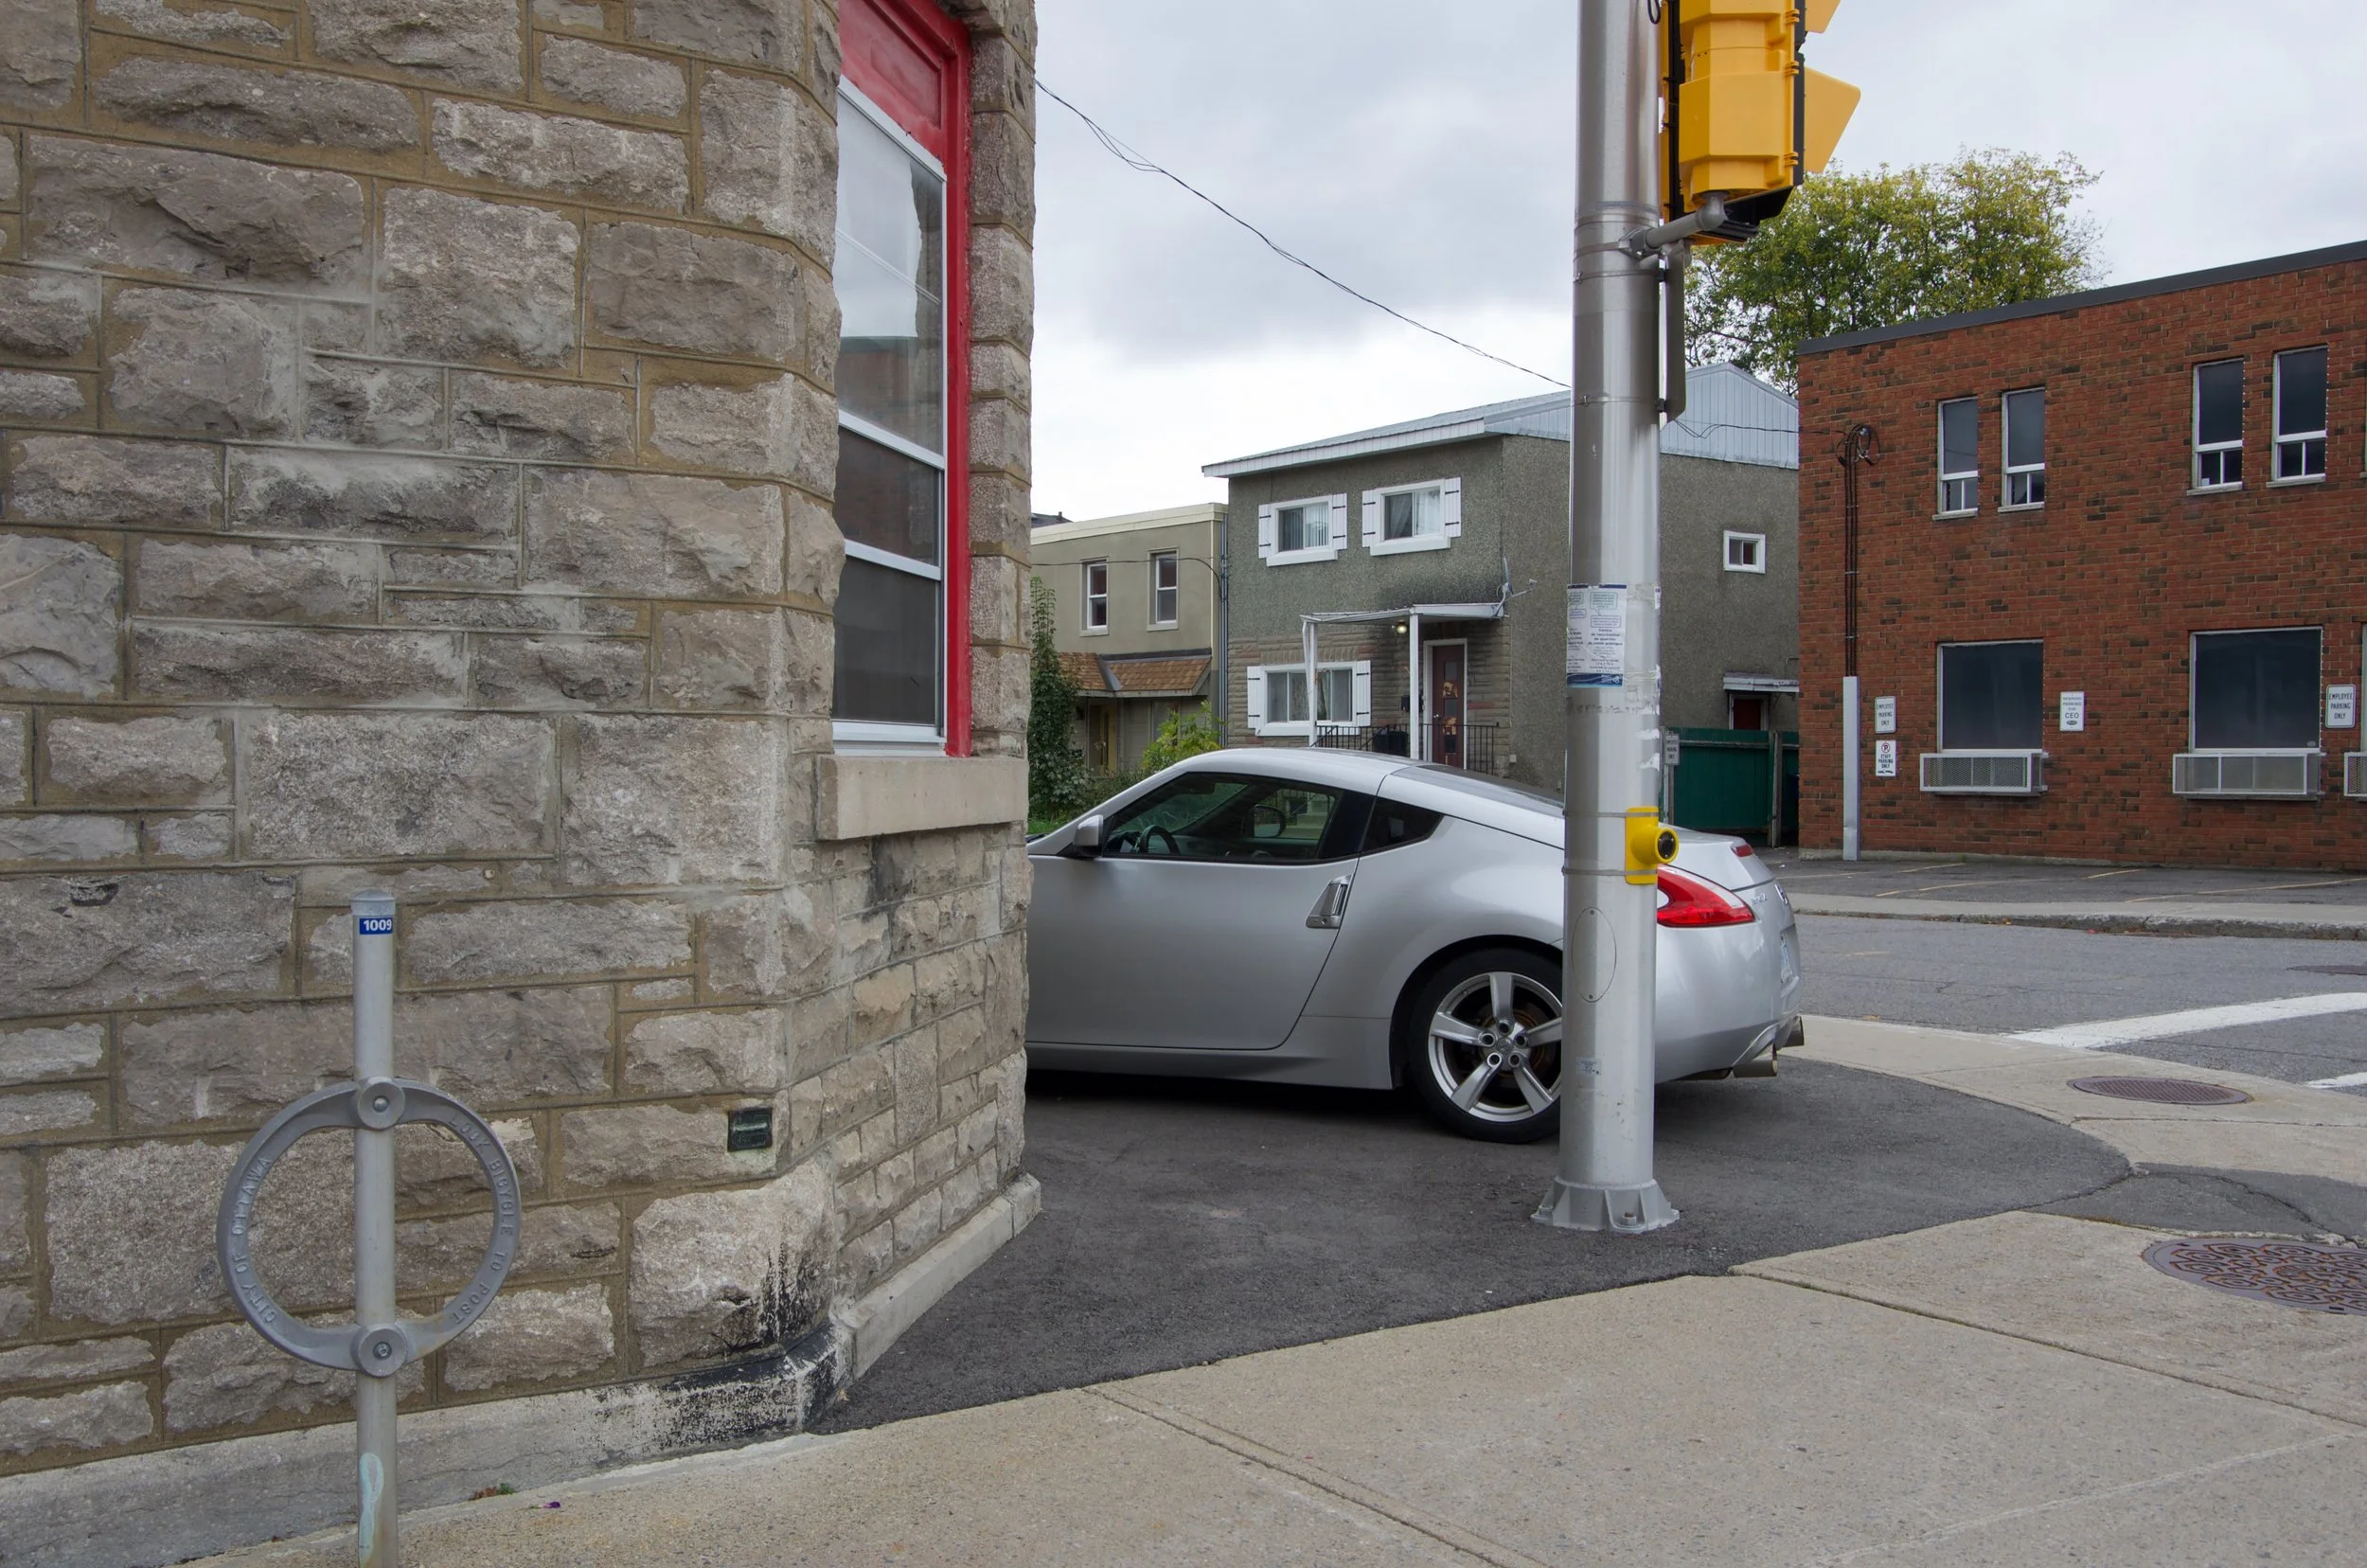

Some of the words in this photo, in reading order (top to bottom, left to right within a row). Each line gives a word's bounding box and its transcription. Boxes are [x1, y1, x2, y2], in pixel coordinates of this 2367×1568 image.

[363, 918, 392, 932] 1009
[232, 1156, 272, 1236] OTTAWA
[489, 1158, 516, 1236] BICYCLE
[231, 1253, 247, 1274] OF
[490, 1251, 507, 1273] TO
[241, 1283, 276, 1323] CITY
[453, 1280, 491, 1326] POST
